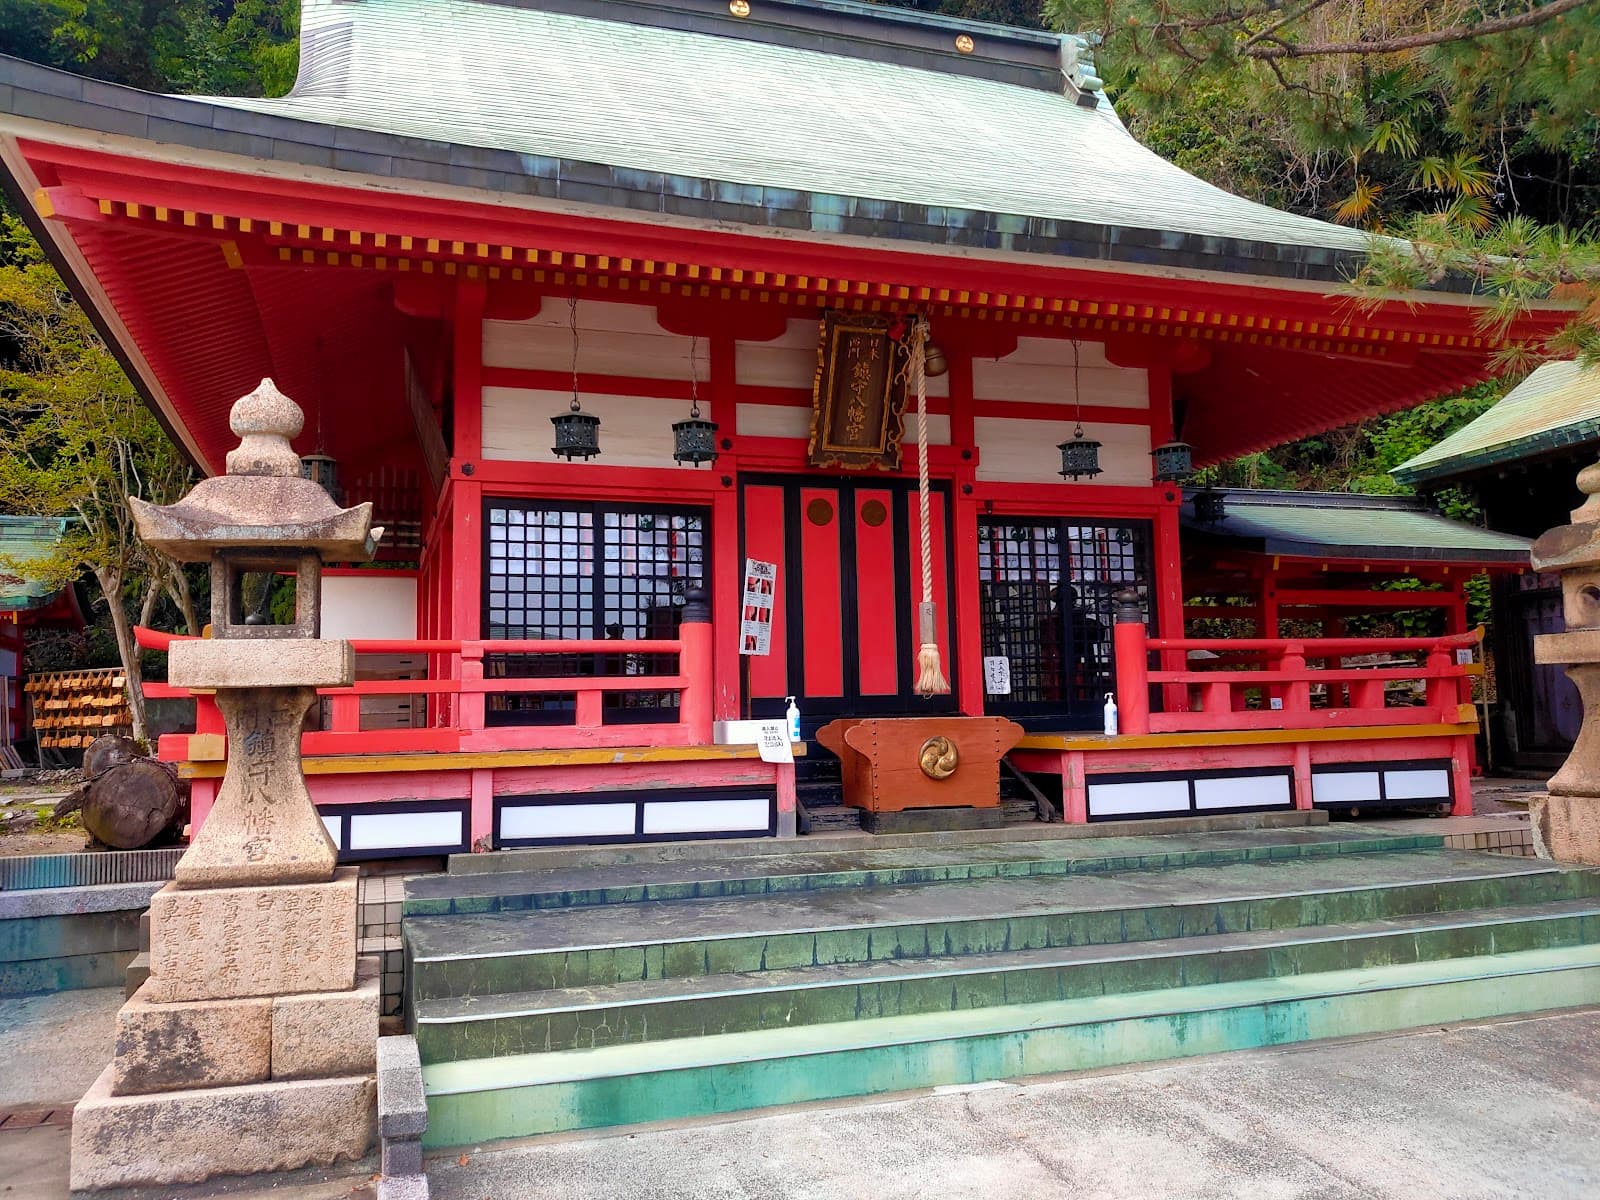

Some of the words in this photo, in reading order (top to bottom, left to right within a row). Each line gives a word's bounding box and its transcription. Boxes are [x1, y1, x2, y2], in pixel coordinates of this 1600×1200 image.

[869, 338, 880, 361] 日本
[846, 362, 873, 441] 鎮守八幡宮
[243, 729, 276, 862] 鎮守八幡宮
